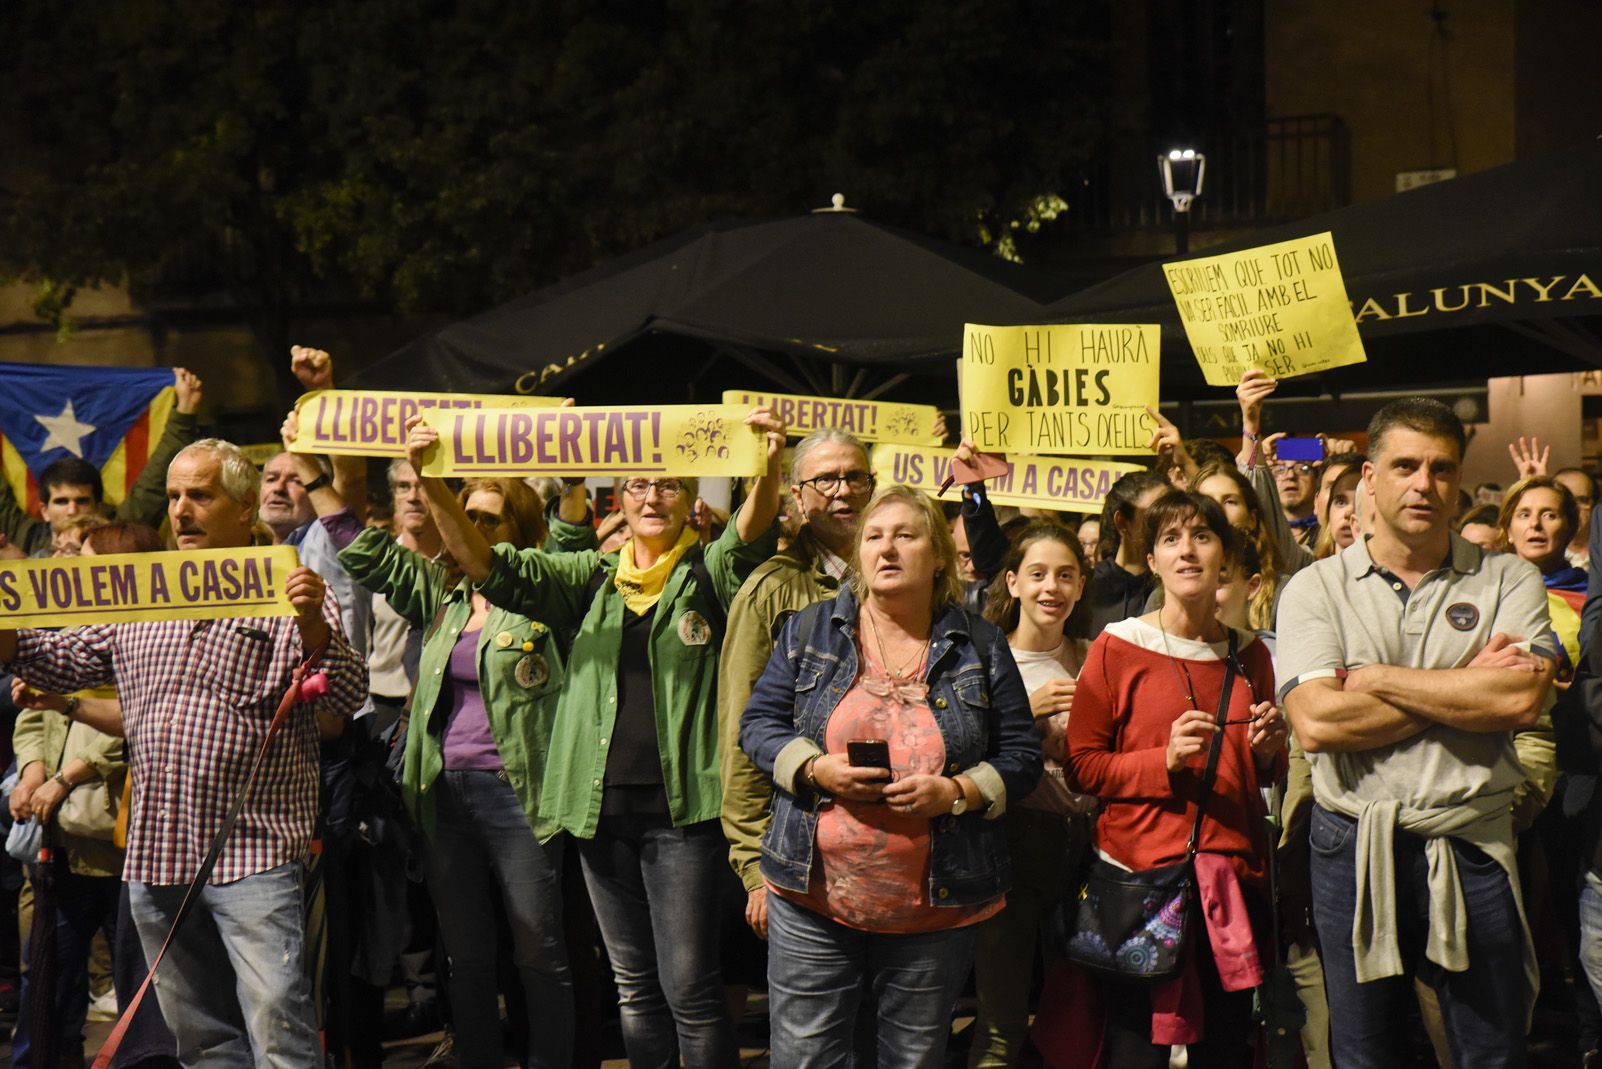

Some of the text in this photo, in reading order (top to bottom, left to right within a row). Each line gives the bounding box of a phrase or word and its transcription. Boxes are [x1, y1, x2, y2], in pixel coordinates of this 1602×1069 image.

[1234, 258, 1268, 288] QUE
[1271, 250, 1302, 281] TOT
[1308, 243, 1333, 272] NO
[1258, 285, 1291, 312] AMB
[1293, 279, 1318, 302] EL
[1348, 273, 1602, 323] ALUNYA
[970, 325, 1149, 365] NO HI HAURÀ
[1217, 312, 1284, 342] SOMRIURE
[1242, 343, 1261, 362] JA
[1265, 338, 1286, 358] NO
[1293, 331, 1313, 351] HI
[1007, 364, 1111, 407] GÀBIES
[1264, 355, 1297, 376] SER
[316, 397, 482, 444] LLIBER
[743, 395, 878, 434] IBERTAT!
[970, 411, 1012, 447] PER
[1026, 411, 1091, 447] TANTS
[453, 412, 663, 464] LLIBERTAT!
[893, 453, 924, 485] US
[1022, 464, 1037, 494] A
[0, 557, 275, 611] S VOLEM A CASA!
